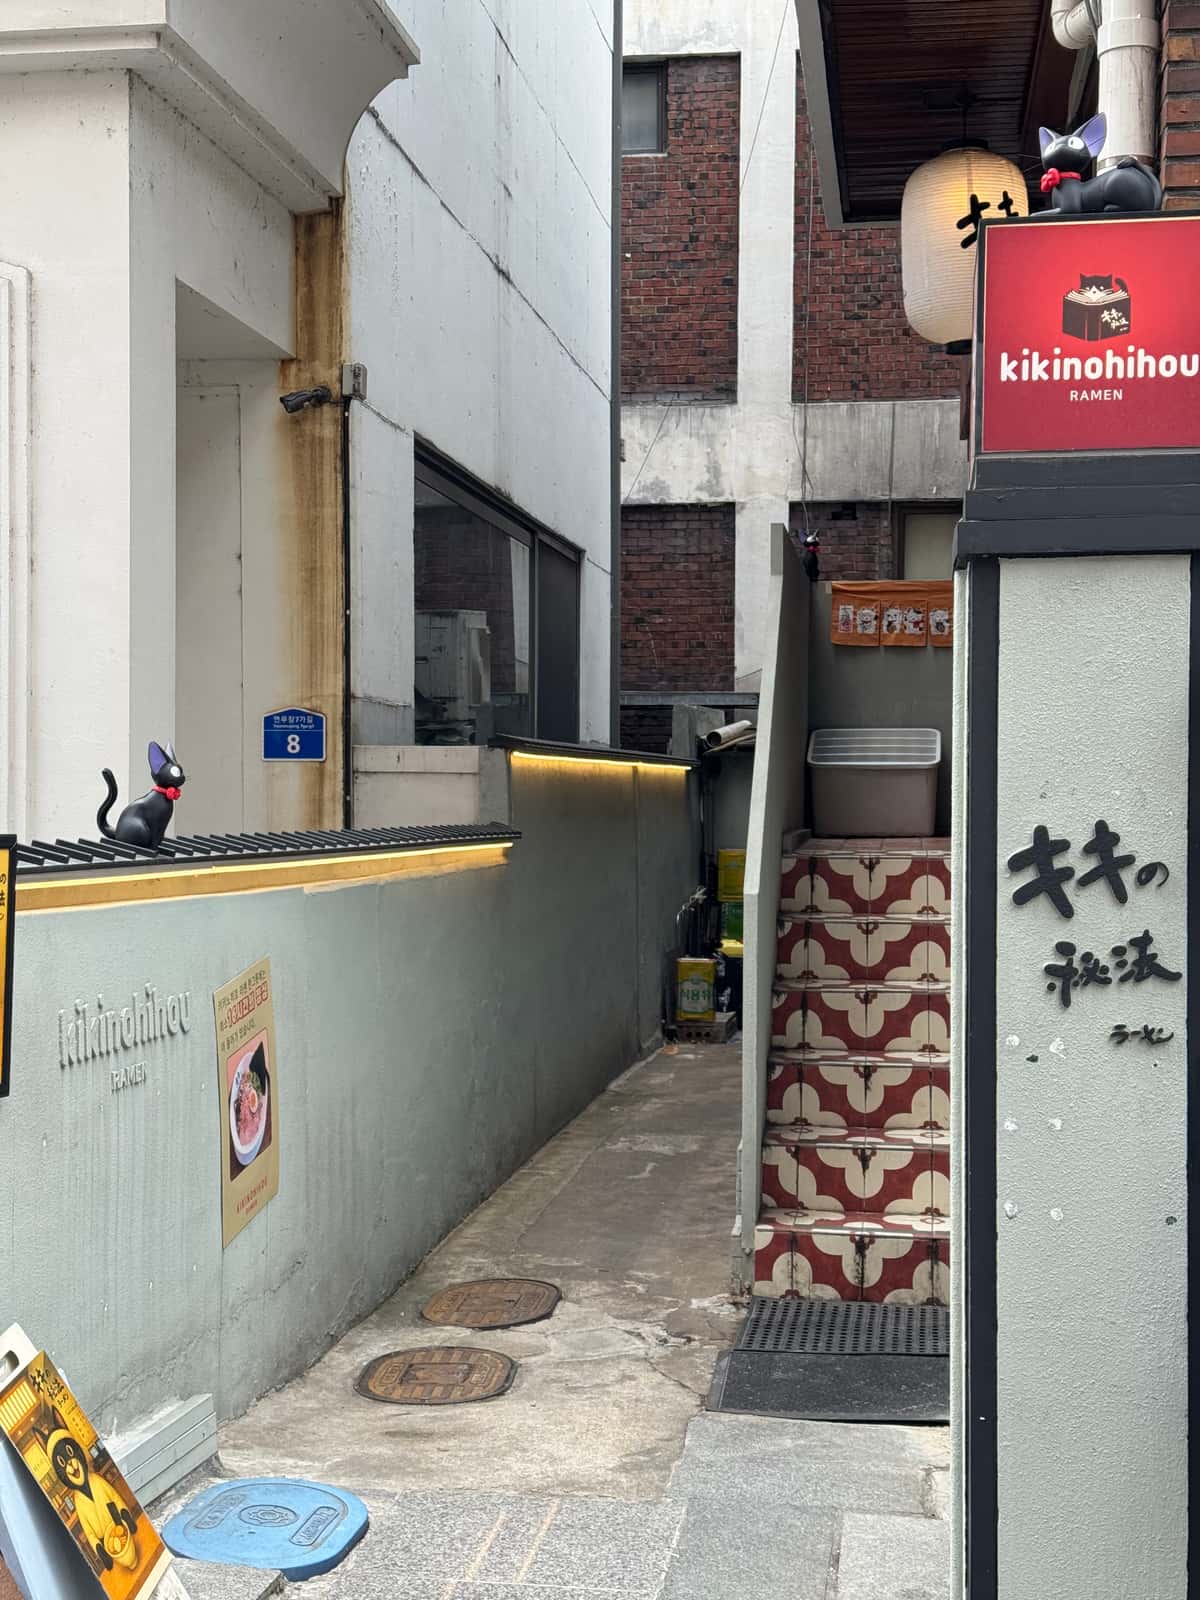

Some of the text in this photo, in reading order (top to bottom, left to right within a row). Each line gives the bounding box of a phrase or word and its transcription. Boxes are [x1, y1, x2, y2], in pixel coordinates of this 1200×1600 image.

[1000, 345, 1200, 382] kikinohihou
[1069, 389, 1123, 401] RAMEN
[287, 734, 300, 754] 8
[1007, 819, 1170, 919] キキの
[58, 982, 191, 1070] kikinohihou
